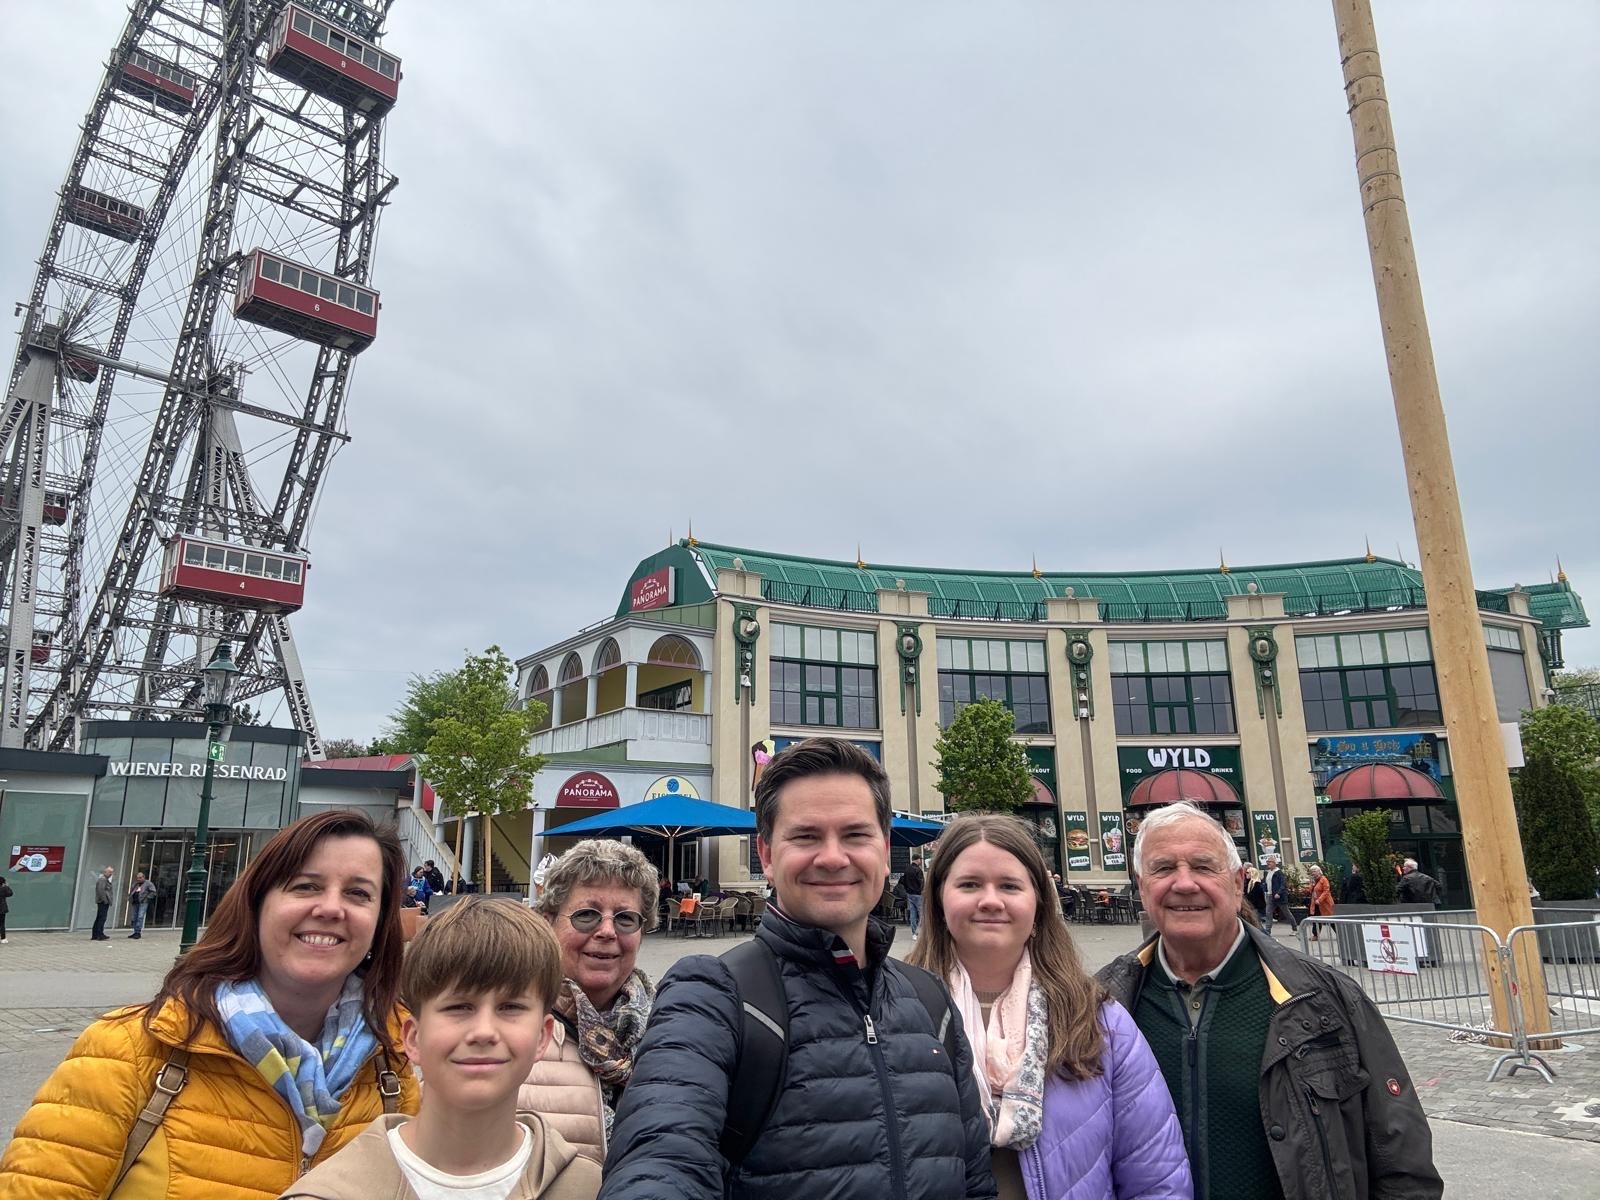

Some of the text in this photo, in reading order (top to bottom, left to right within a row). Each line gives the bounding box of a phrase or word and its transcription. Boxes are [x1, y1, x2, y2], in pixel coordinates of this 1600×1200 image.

[314, 303, 320, 312] 6
[239, 581, 245, 590] 4
[632, 584, 667, 608] PANORAMA
[1147, 748, 1211, 768] WYLD
[110, 762, 183, 776] WIENER
[564, 788, 613, 798] PANORAMA
